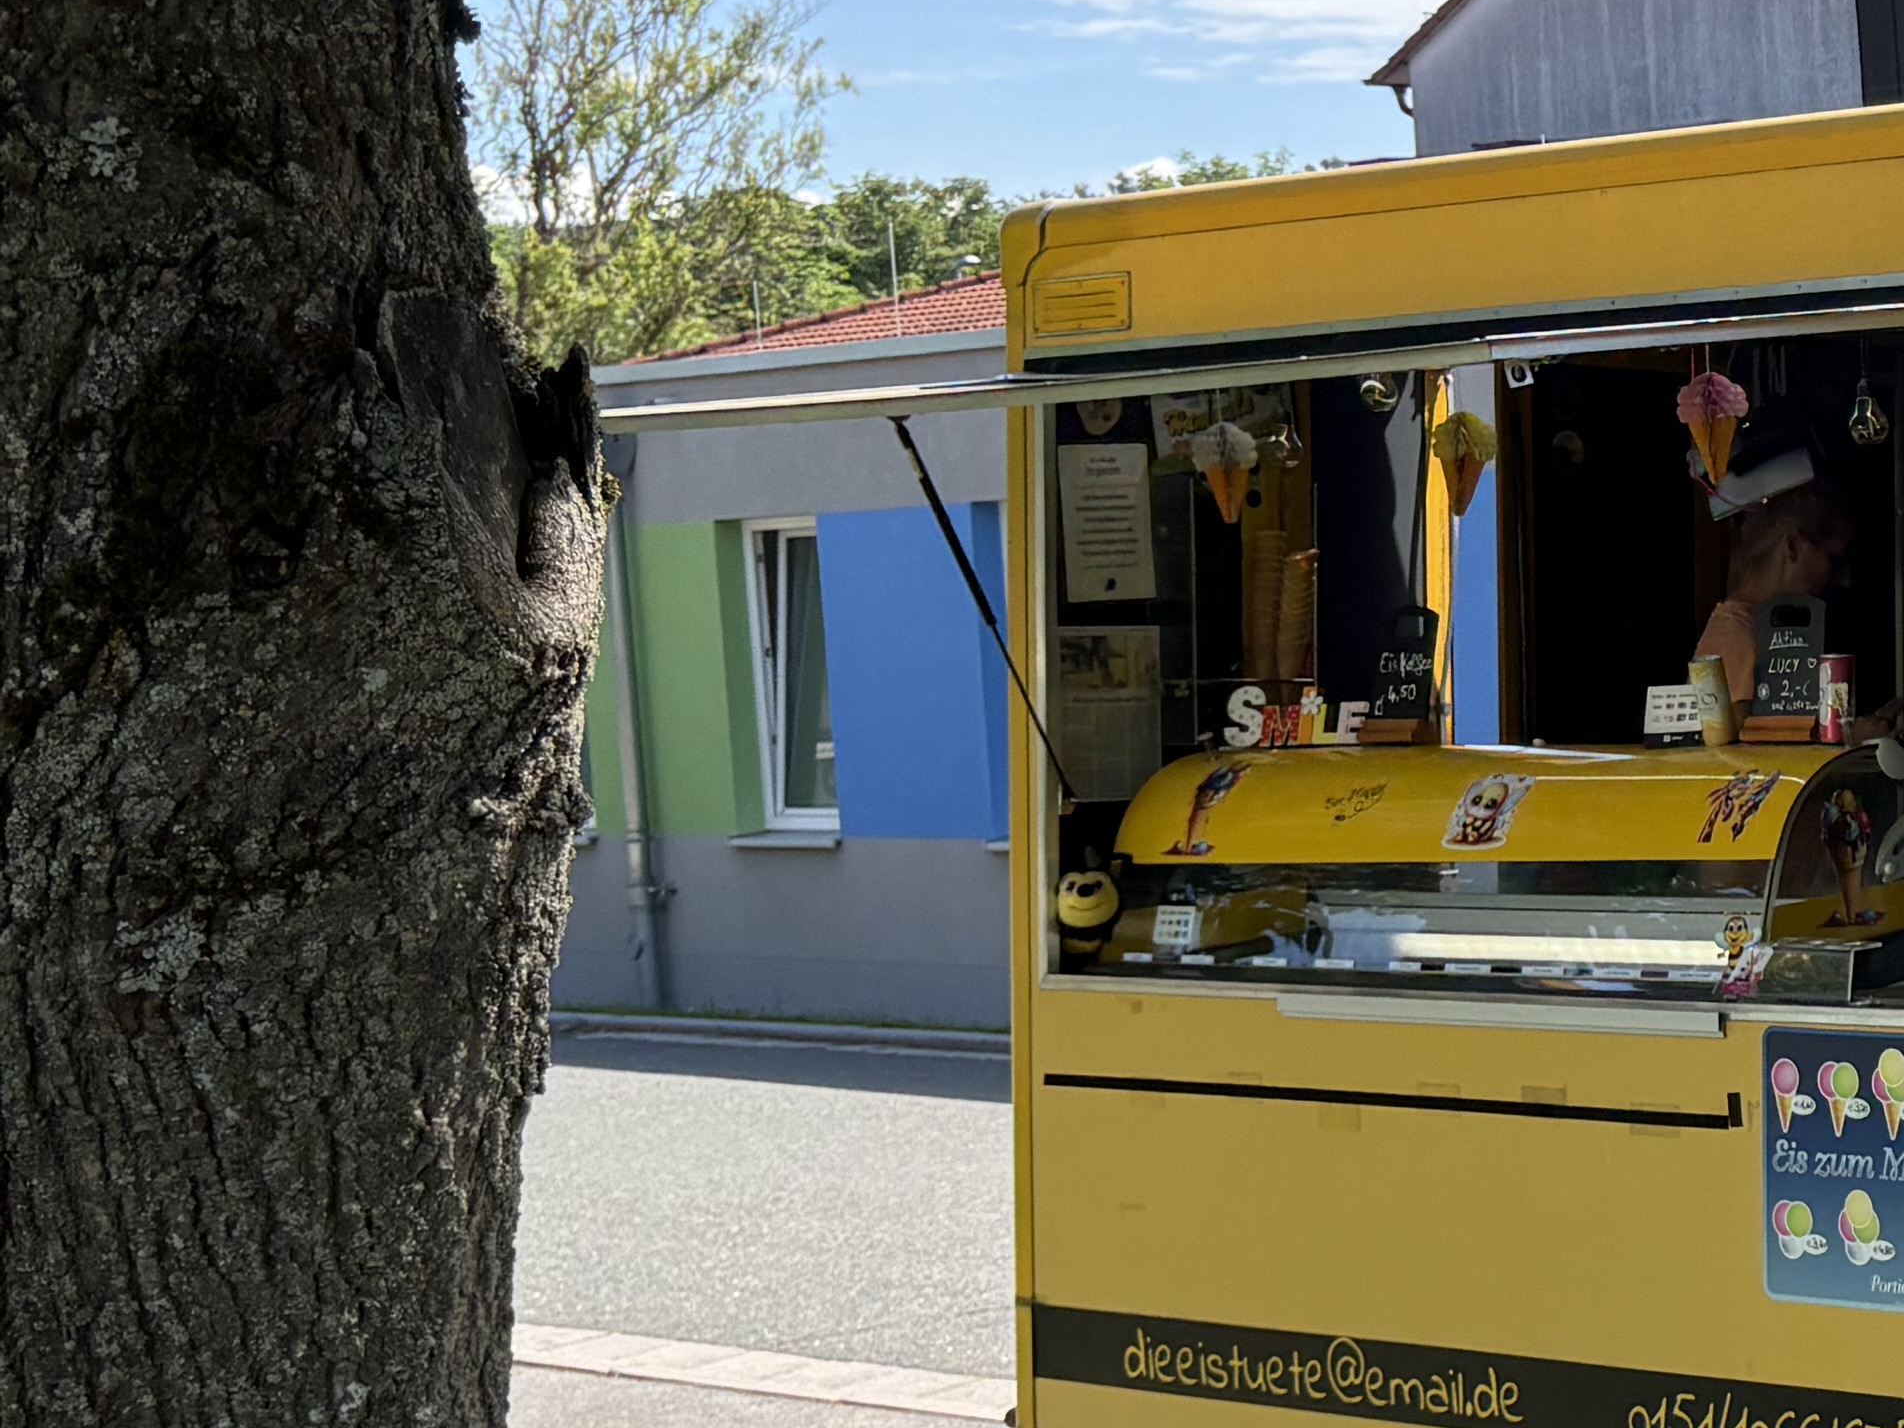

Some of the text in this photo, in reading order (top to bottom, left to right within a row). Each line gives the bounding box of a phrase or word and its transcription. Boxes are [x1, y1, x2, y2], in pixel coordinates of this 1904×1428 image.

[1768, 657, 1800, 674] LUCY
[1772, 1138, 1808, 1175] Eis
[1814, 1152, 1875, 1179] zum
[1124, 1328, 1523, 1423] dieeistuete@email.de
